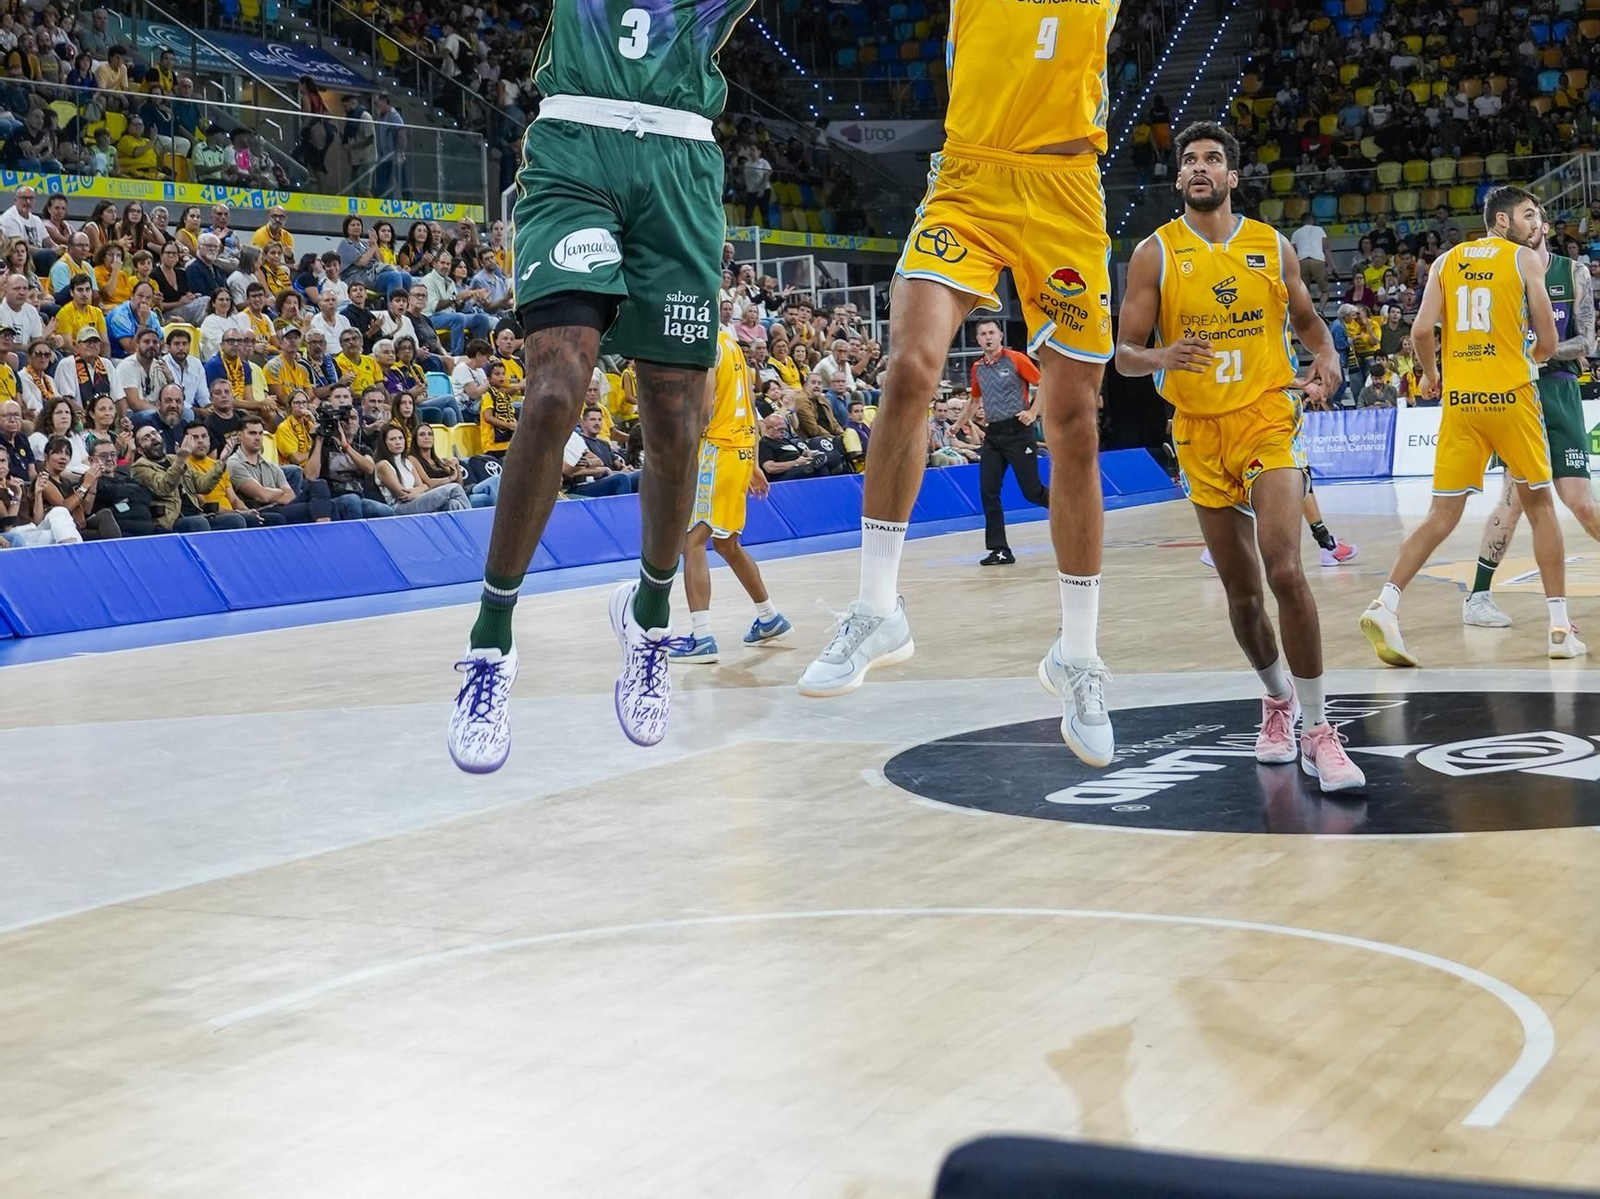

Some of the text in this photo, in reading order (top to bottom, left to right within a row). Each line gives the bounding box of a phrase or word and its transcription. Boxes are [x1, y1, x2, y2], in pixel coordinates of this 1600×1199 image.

[618, 8, 651, 60] 3
[1034, 16, 1059, 60] 9
[664, 303, 671, 313] a
[666, 291, 699, 304] sabor
[1040, 292, 1089, 320] Poema
[1180, 308, 1264, 326] DREAMLAND
[1456, 285, 1493, 334] 18
[664, 315, 709, 344] laga
[1062, 315, 1084, 332] Mar
[1215, 349, 1243, 384] 21
[1313, 435, 1347, 445] agencia
[1349, 433, 1360, 442] de
[1362, 431, 1387, 443] viajes
[1313, 444, 1326, 453] las
[1327, 444, 1346, 453] Islas
[1347, 442, 1387, 452] Canarias
